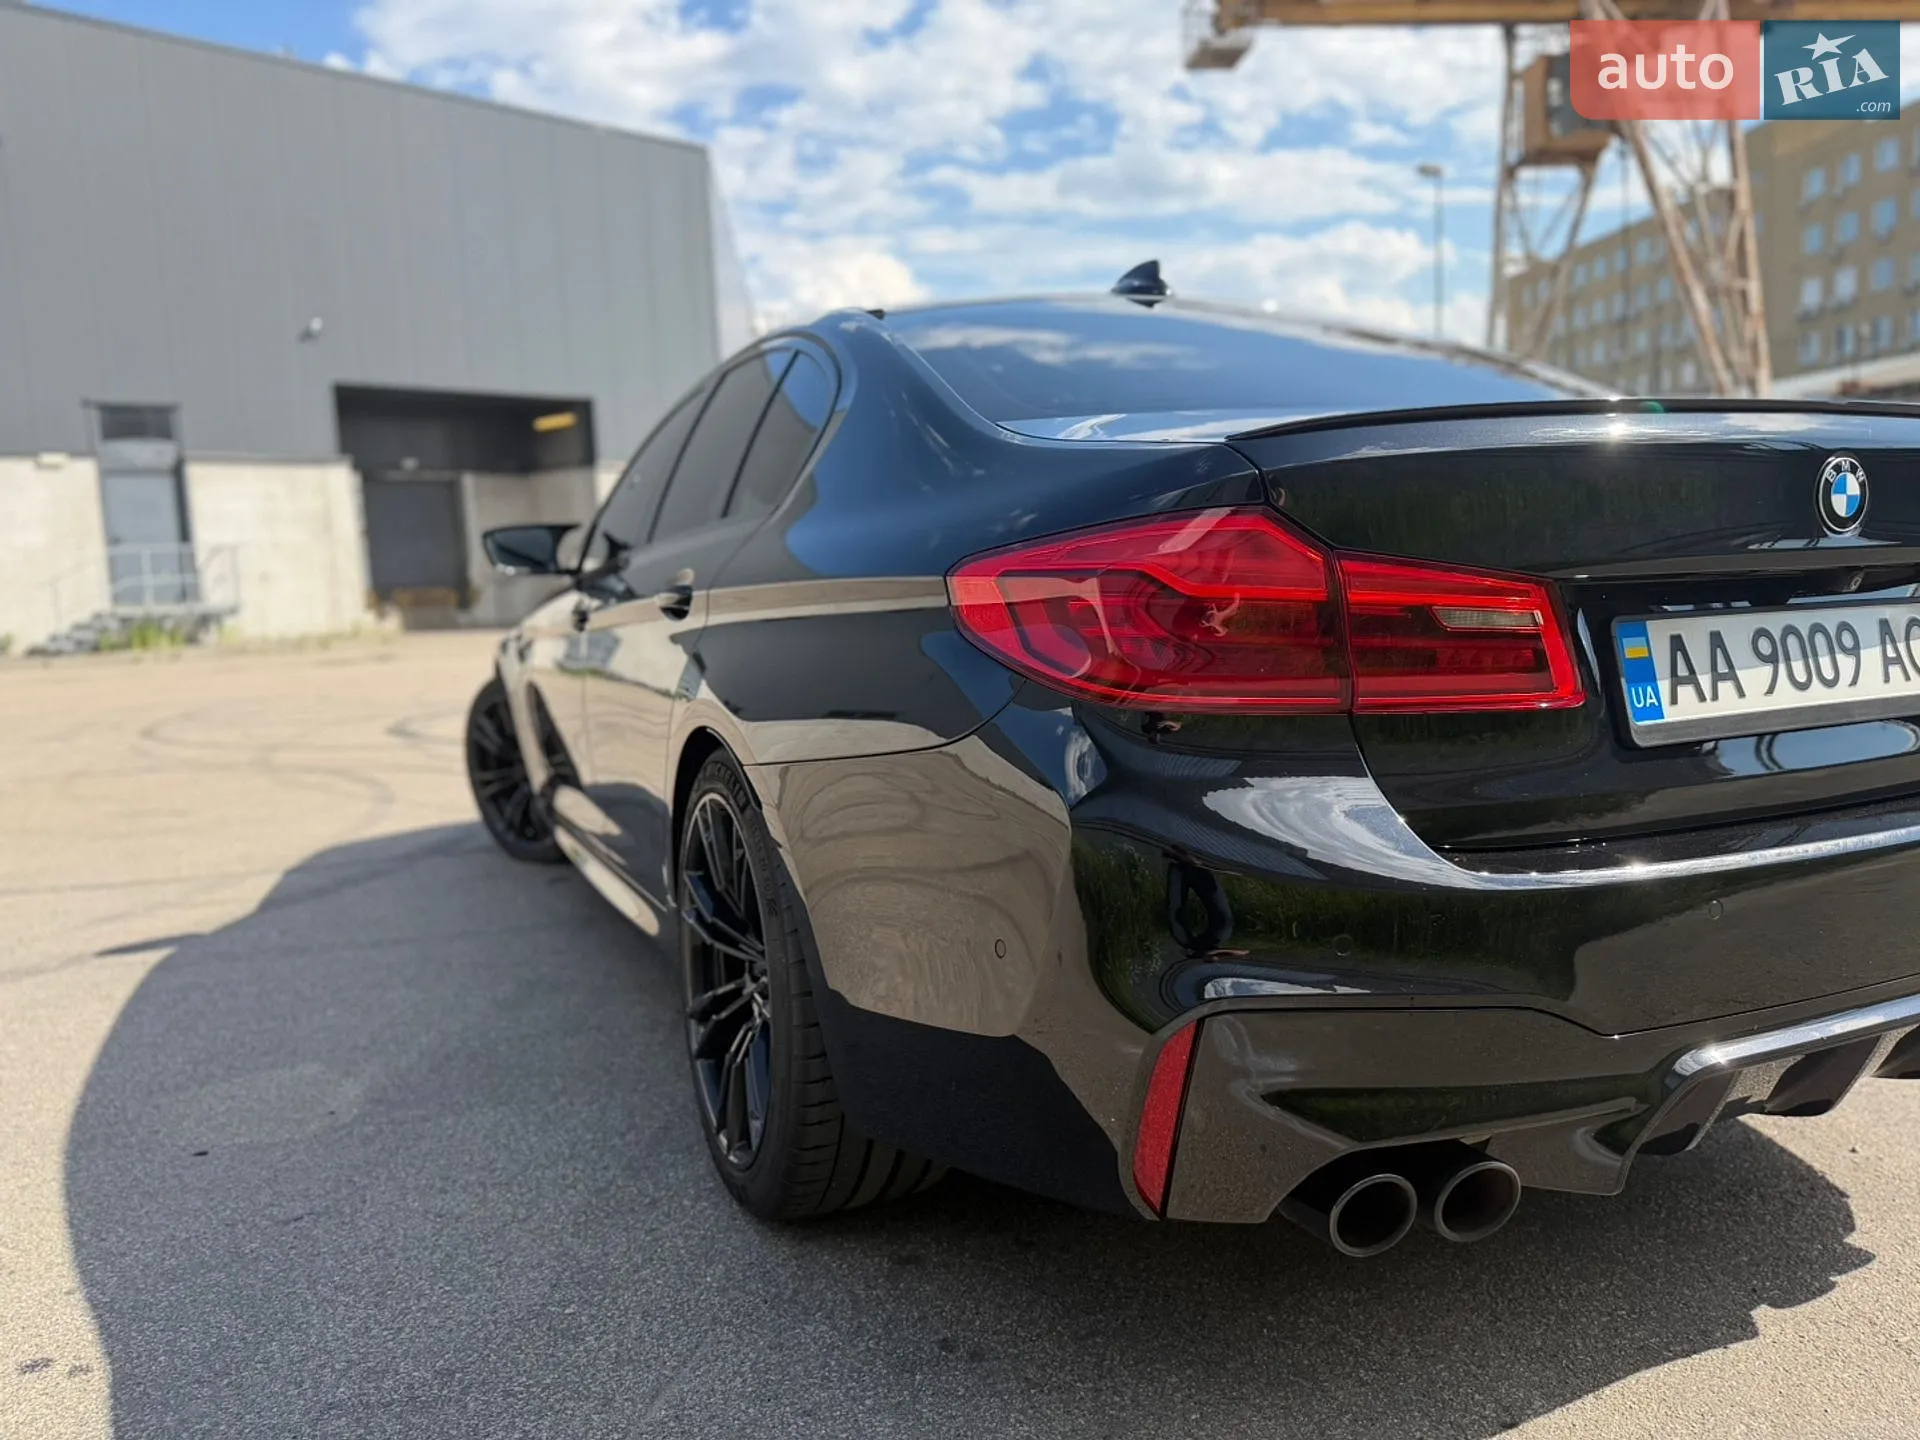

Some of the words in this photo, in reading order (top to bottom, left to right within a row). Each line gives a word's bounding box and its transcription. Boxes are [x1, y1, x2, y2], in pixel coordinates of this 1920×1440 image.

[1826, 460, 1866, 483] BMW
[1669, 630, 1746, 705] AA
[1752, 621, 1861, 696] 9009
[1630, 686, 1659, 708] UA
